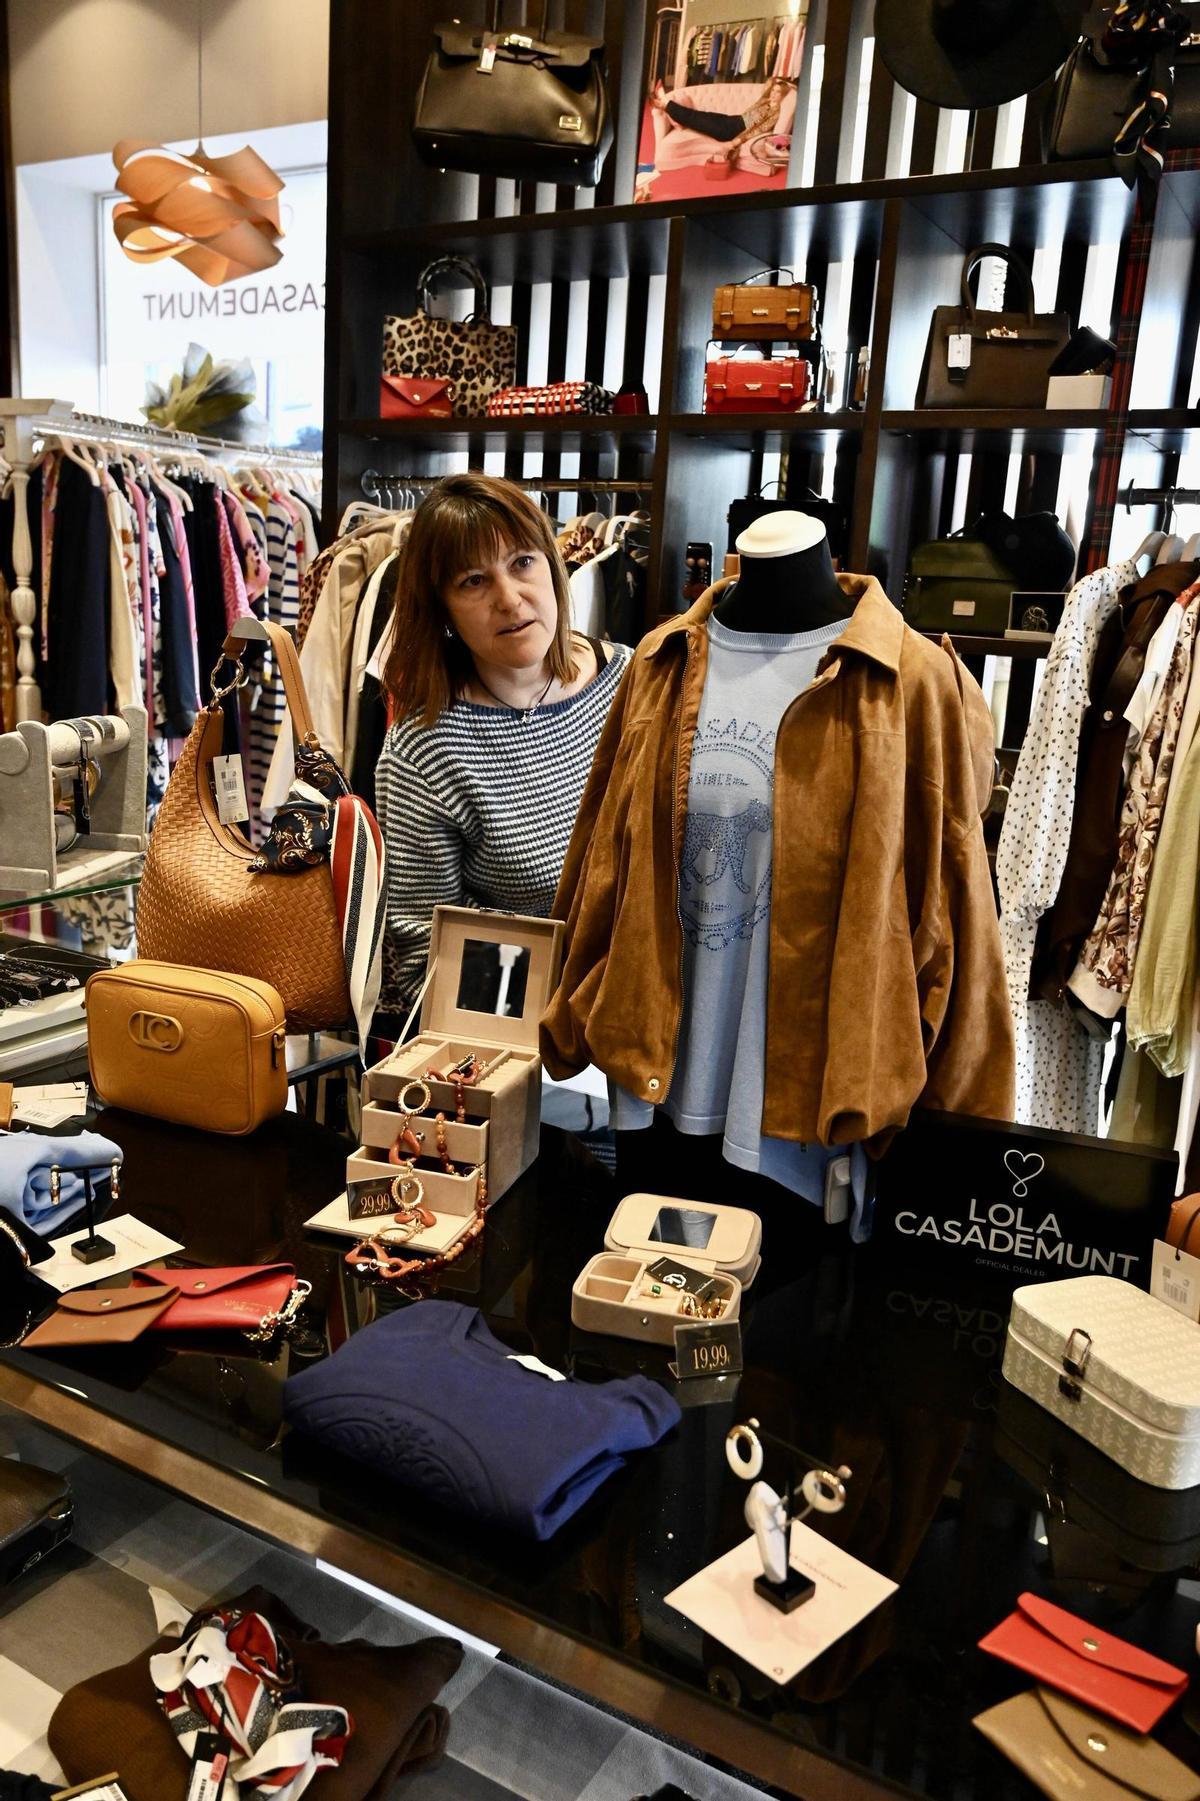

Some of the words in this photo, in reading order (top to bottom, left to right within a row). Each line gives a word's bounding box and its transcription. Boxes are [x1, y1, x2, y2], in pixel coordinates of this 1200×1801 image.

[969, 1198, 1062, 1238] LOLA
[895, 1211, 1140, 1278] CASADEMUNT
[975, 1257, 1011, 1271] OFFICIAL
[1012, 1265, 1046, 1277] DEALER
